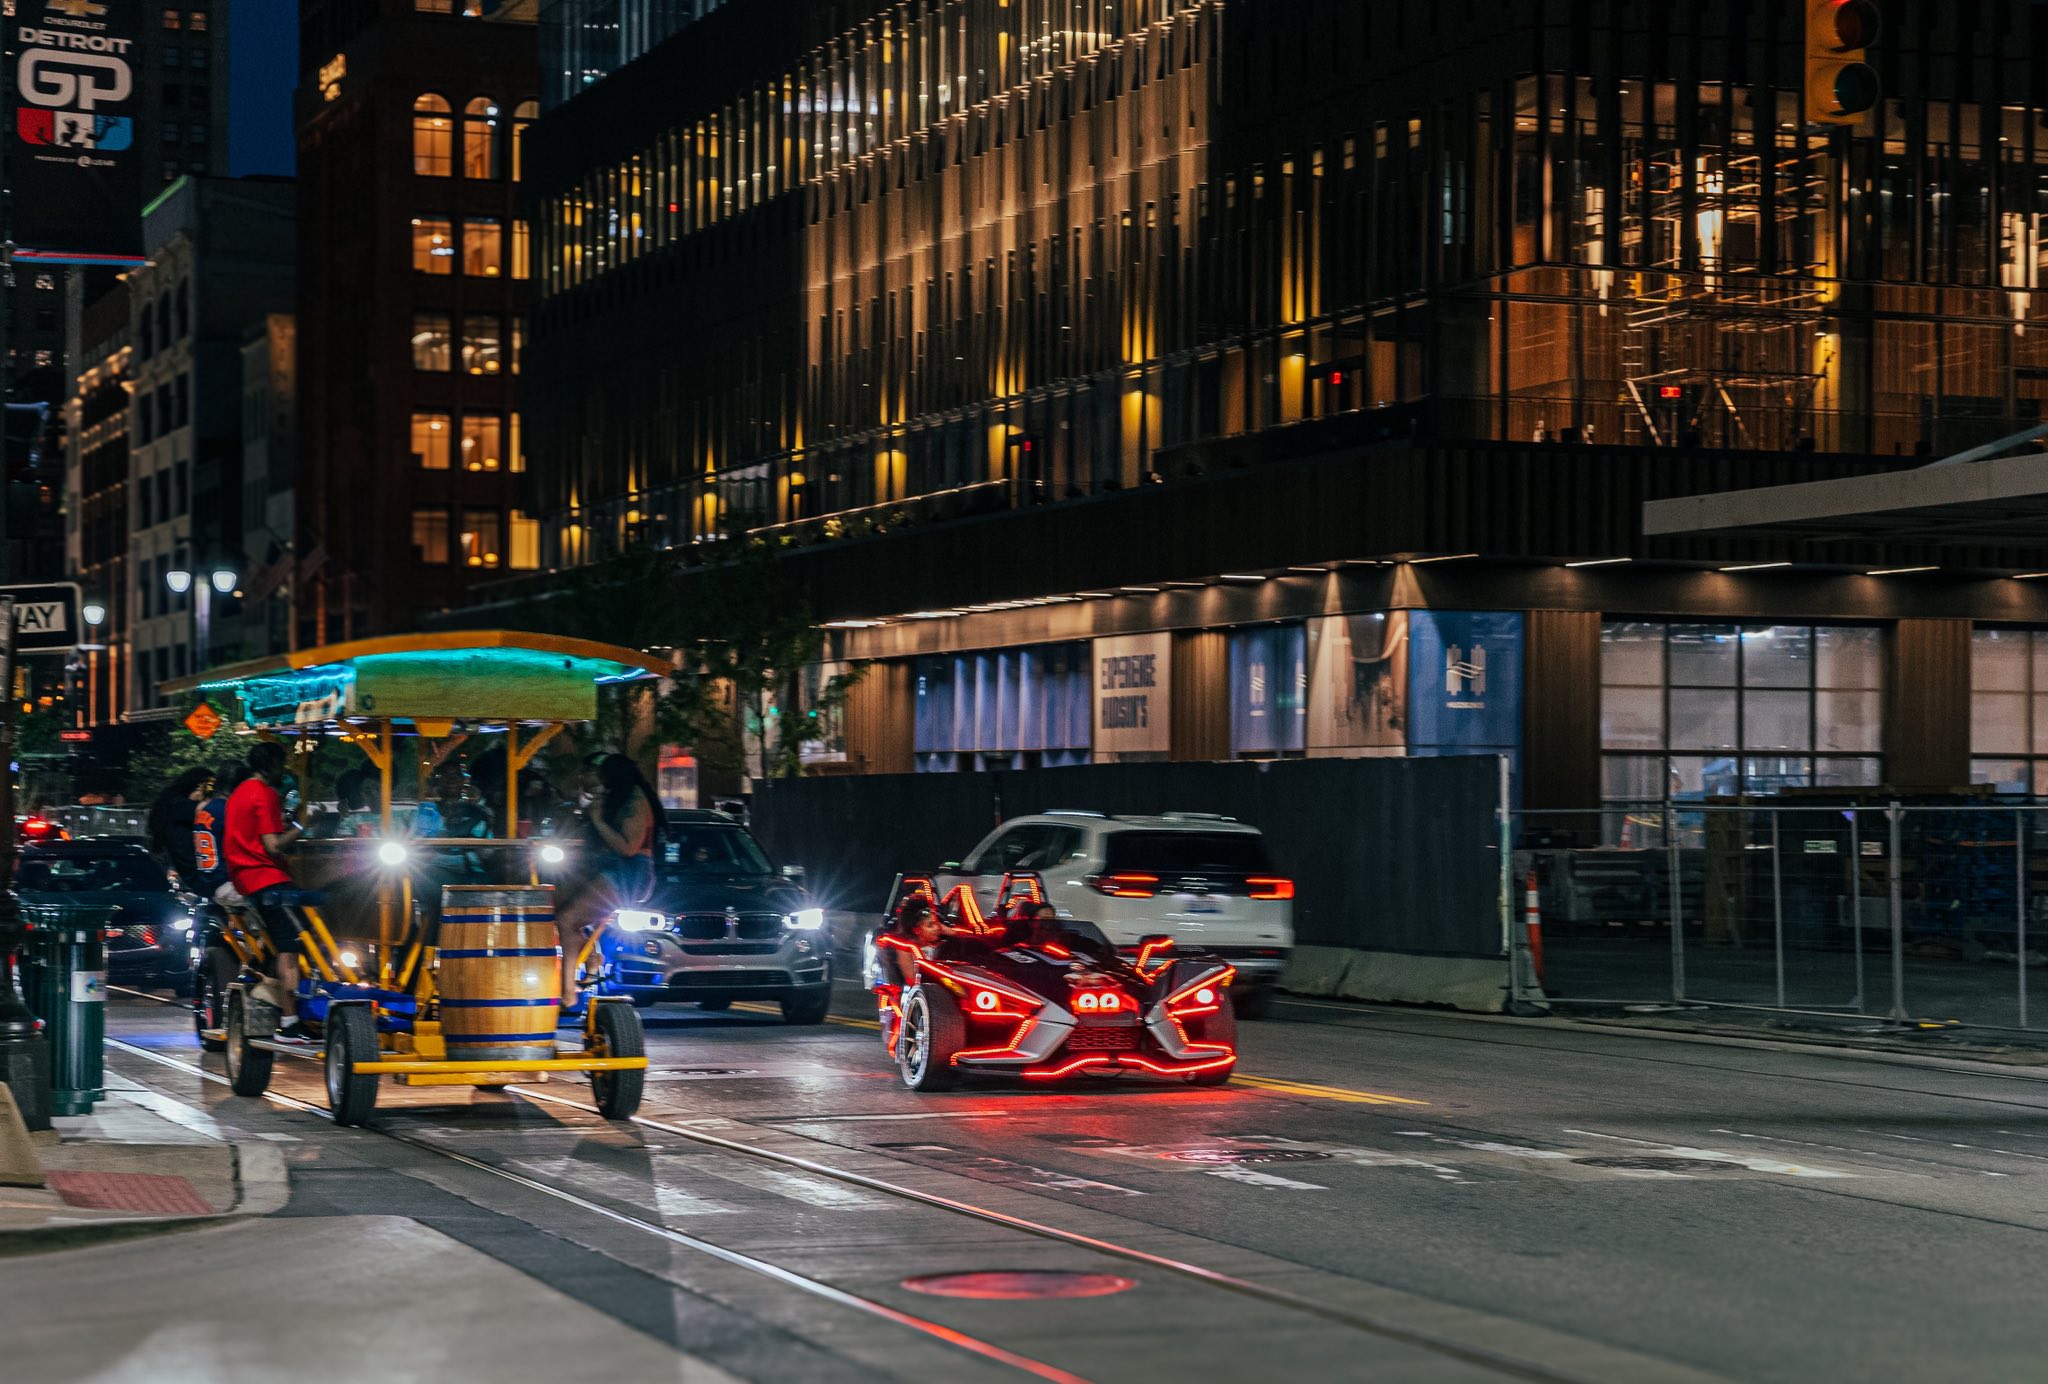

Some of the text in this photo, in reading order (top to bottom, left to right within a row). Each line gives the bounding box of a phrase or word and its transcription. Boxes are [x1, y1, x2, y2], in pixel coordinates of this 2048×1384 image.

[18, 26, 132, 54] DETROIT
[17, 47, 132, 110] GP
[192, 830, 219, 871] 9
